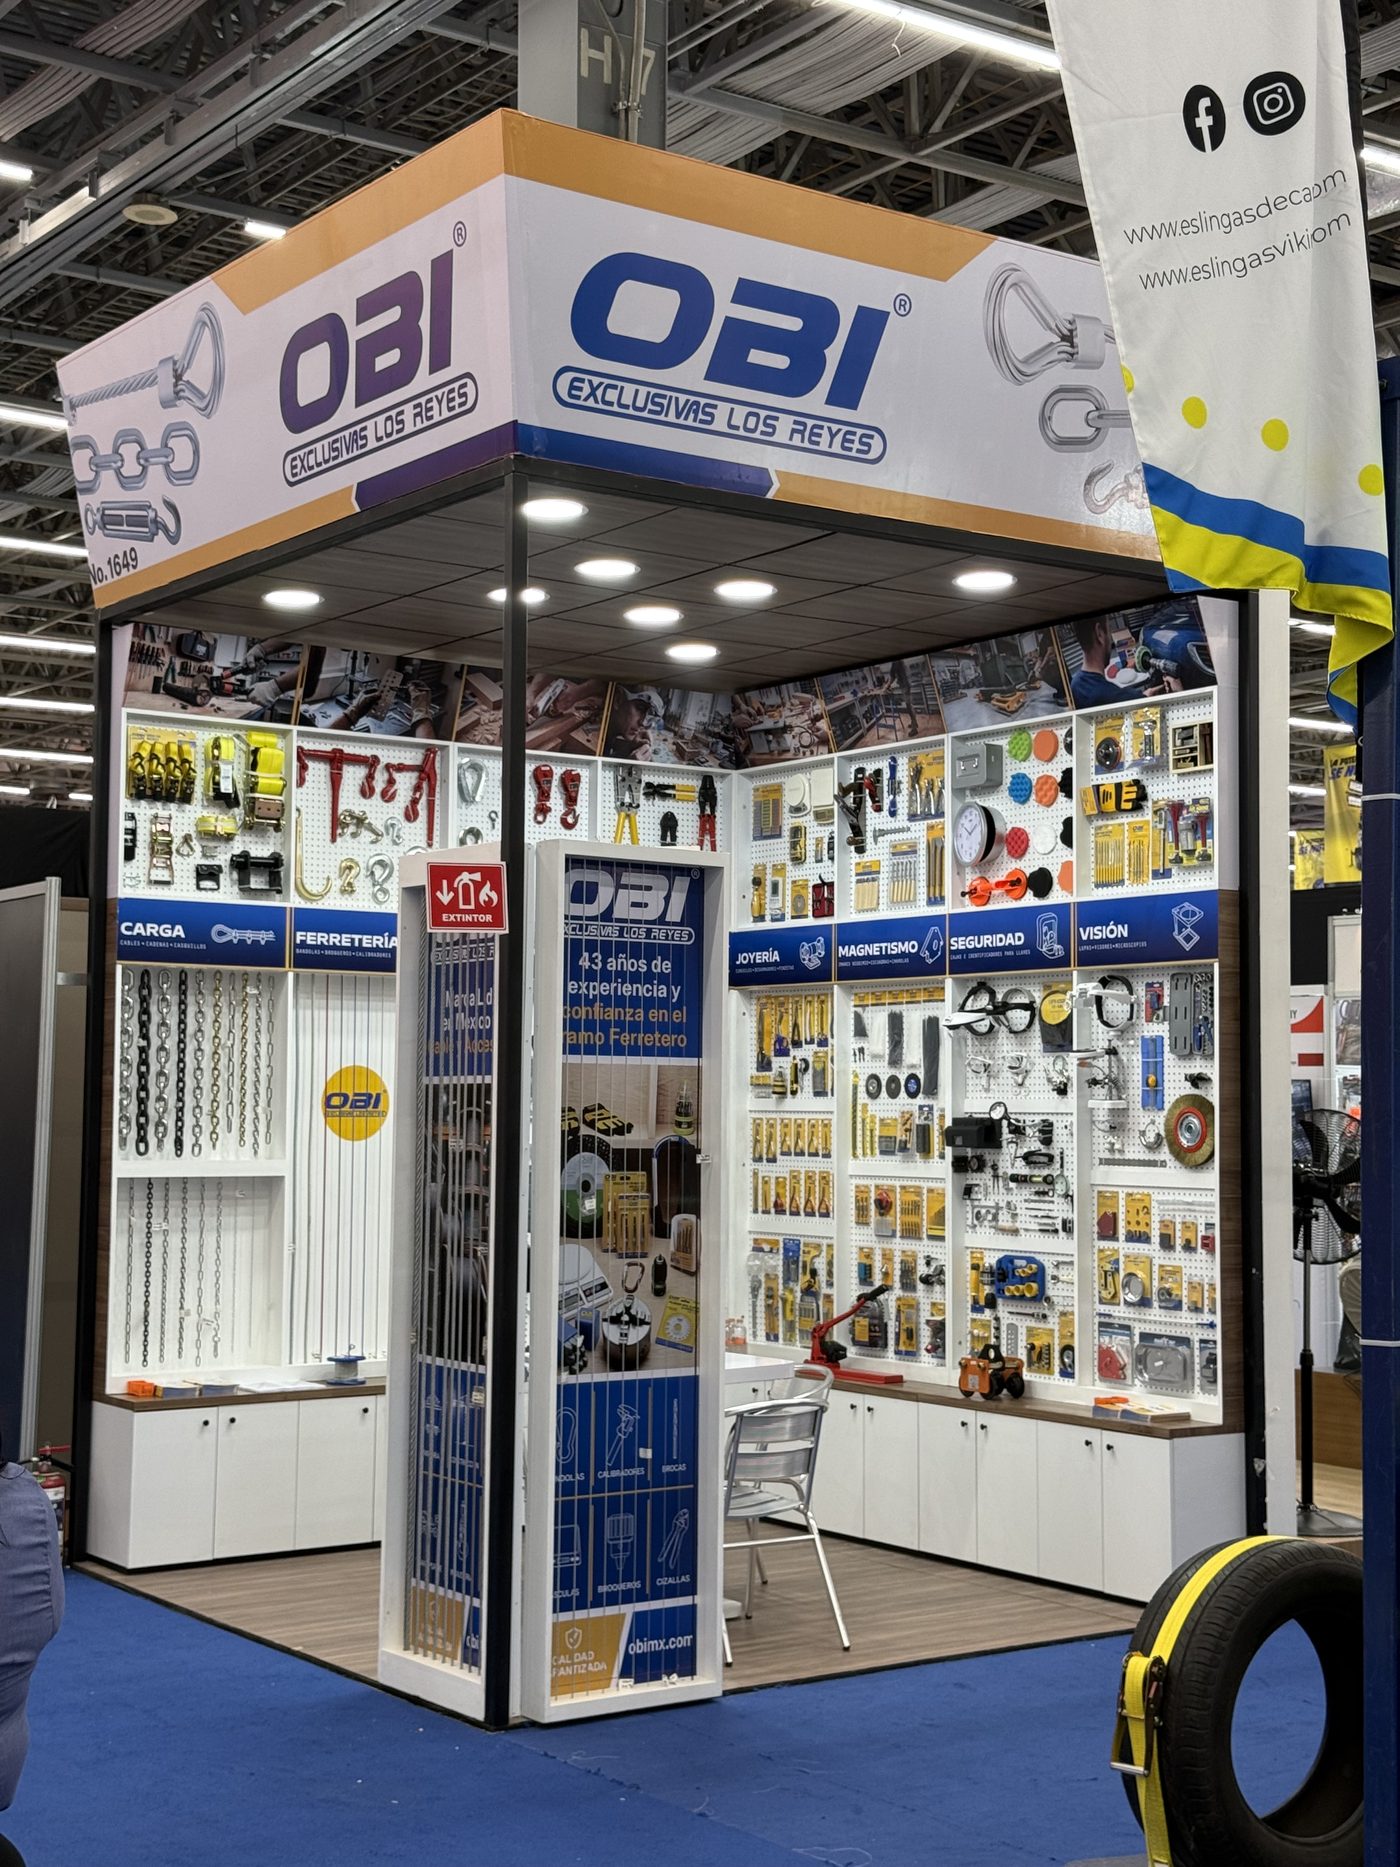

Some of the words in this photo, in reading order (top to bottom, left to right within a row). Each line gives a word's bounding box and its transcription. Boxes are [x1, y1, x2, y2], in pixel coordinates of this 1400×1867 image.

[580, 28, 612, 84] H
[570, 251, 891, 411] OBI
[280, 248, 453, 435] OBI
[567, 376, 718, 426] EXCLUSIVAS
[726, 407, 780, 437] LOS
[788, 420, 875, 456] REYES
[290, 425, 368, 480] EXCLUSIVAS
[374, 409, 405, 443] LOS
[412, 381, 469, 428] REYES
[564, 868, 691, 923] OBI
[442, 913, 493, 922] EXTINTOR
[120, 921, 186, 939] CARGA
[295, 930, 398, 949] FERRETERÍA
[623, 926, 647, 939] LOS
[651, 928, 690, 941] REYES
[1079, 920, 1129, 941] VISIÓN
[145, 940, 169, 948] CADENAS
[838, 940, 919, 958] MAGNETISMO
[950, 931, 1025, 950] SEGURIDAD
[579, 951, 603, 970] 43
[606, 953, 648, 973] años
[651, 956, 672, 974] de
[735, 947, 780, 965] JOYERÍA
[567, 978, 667, 999] experiencia
[670, 984, 681, 1003] y
[648, 1008, 669, 1022] en
[672, 1006, 687, 1023] el
[608, 1028, 687, 1047] Ferretero
[325, 1092, 381, 1109] OBI
[661, 1463, 687, 1473] BROCAS
